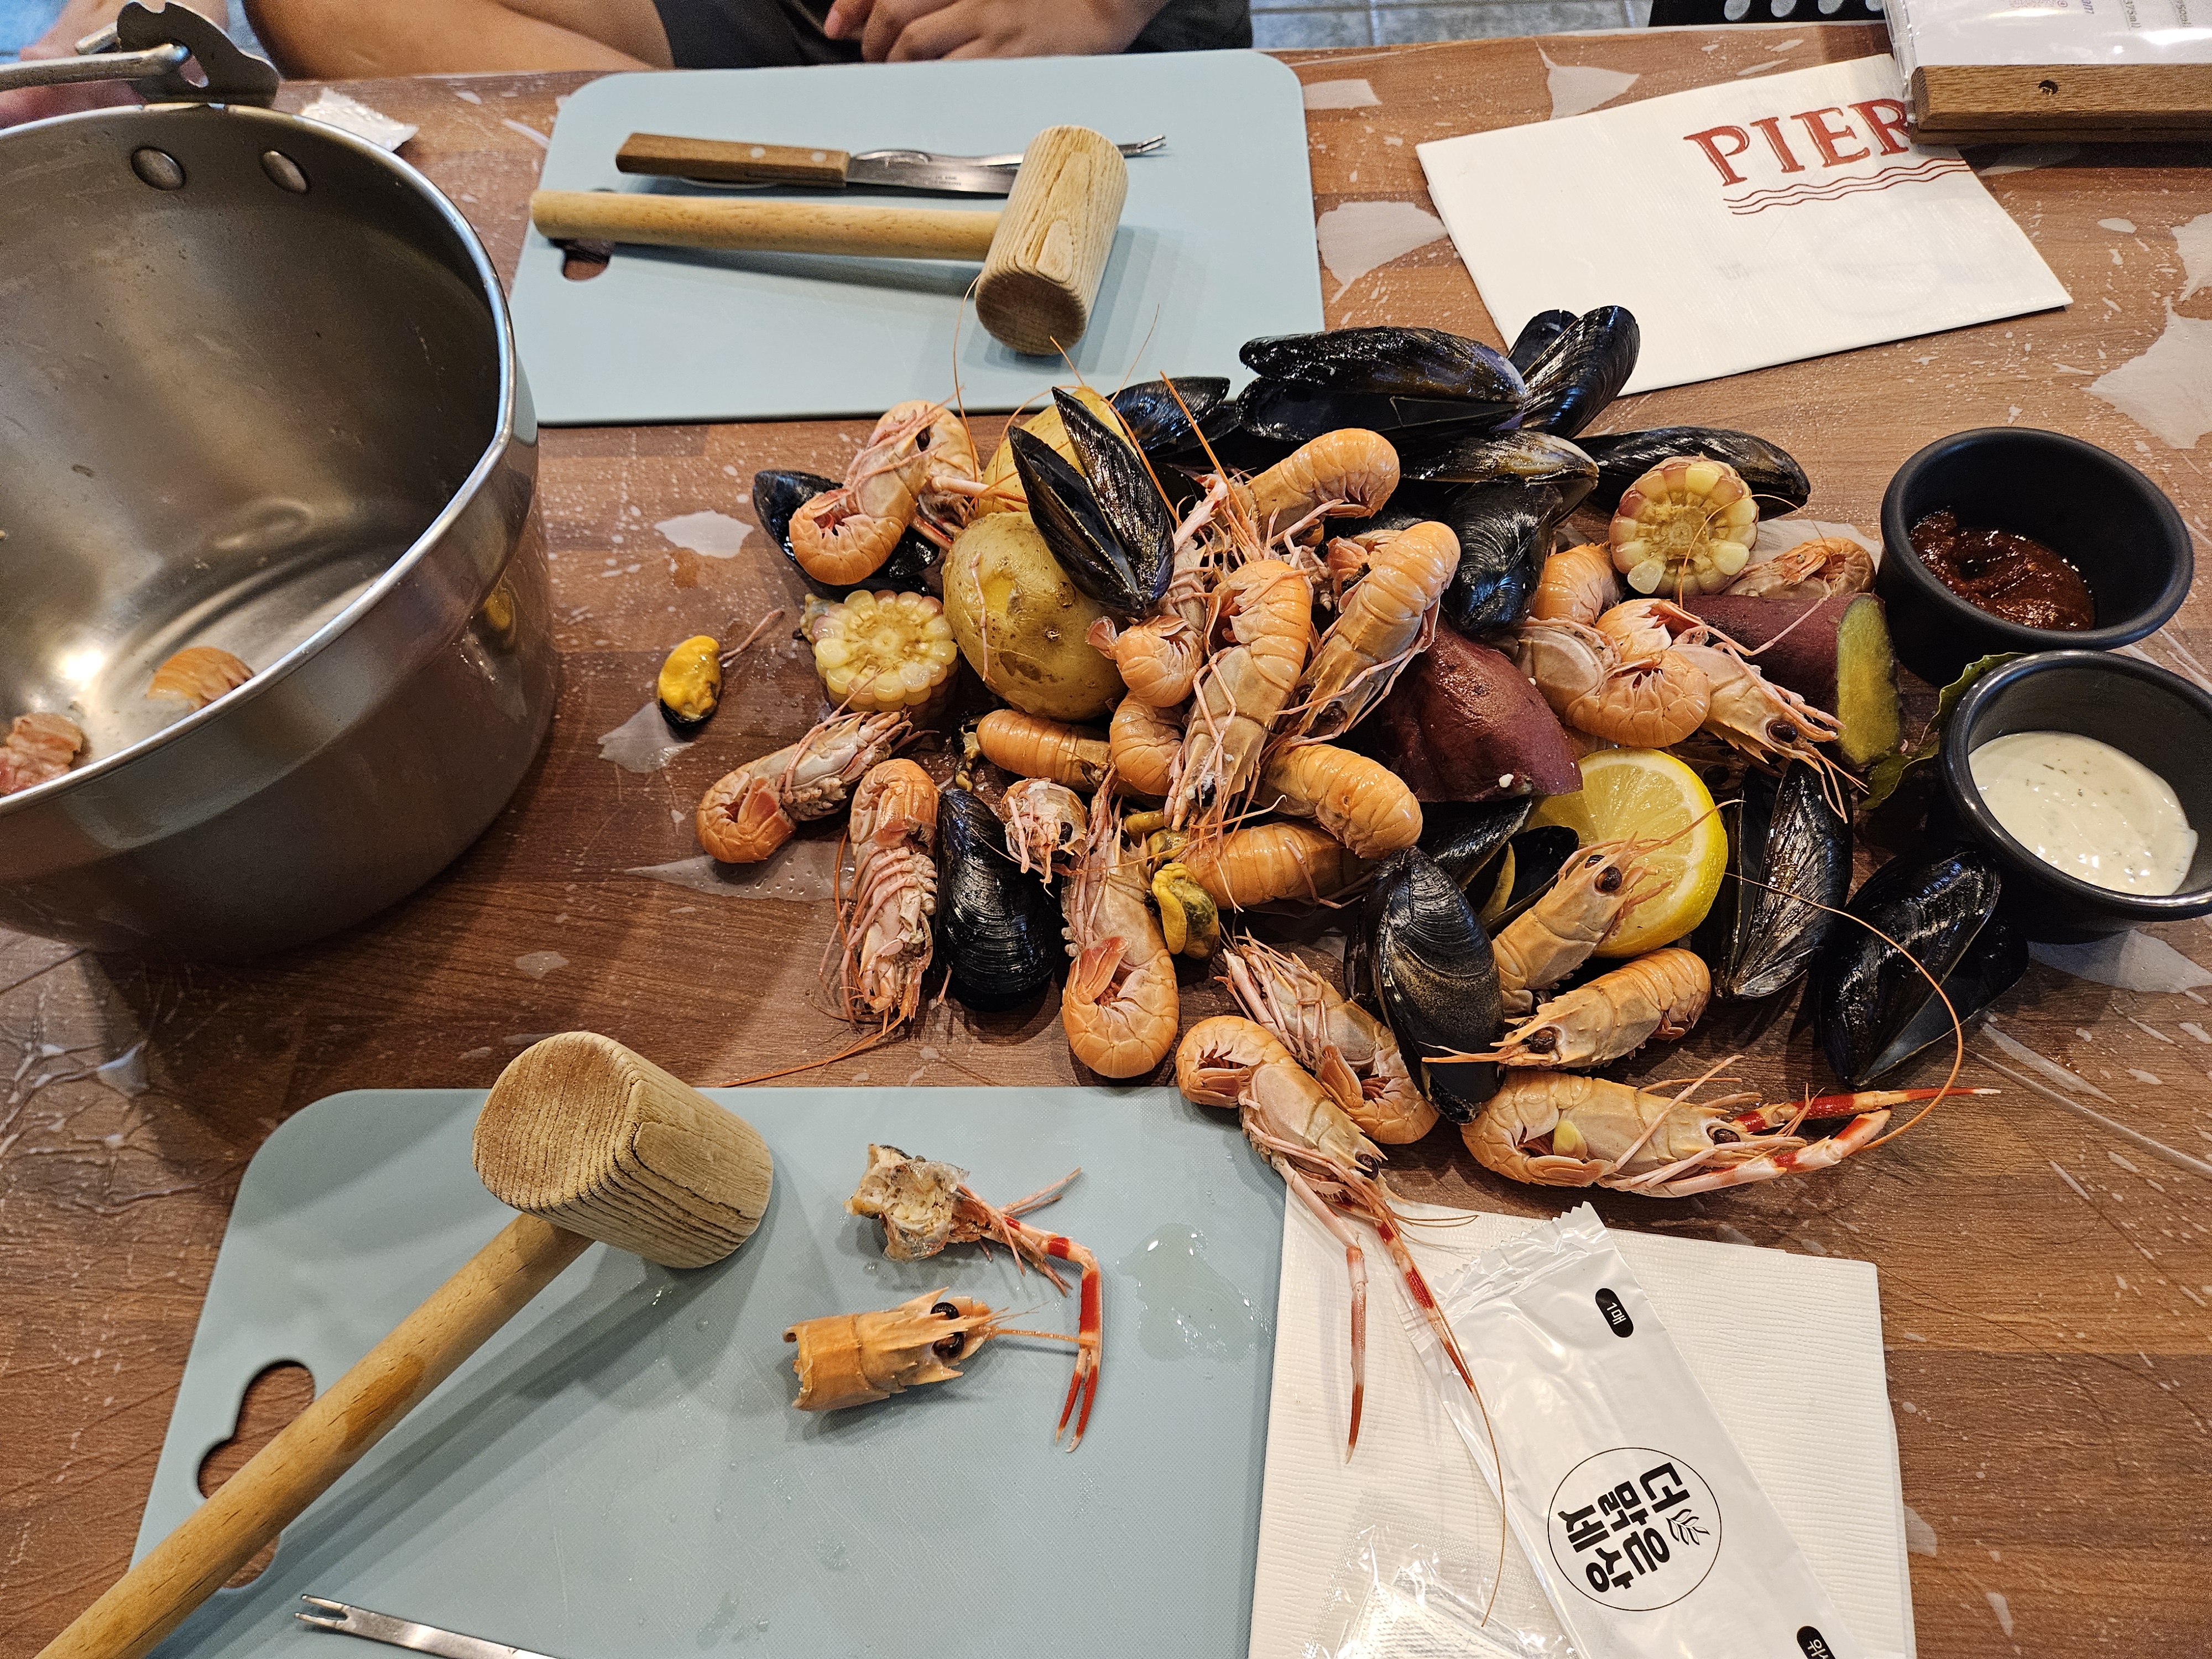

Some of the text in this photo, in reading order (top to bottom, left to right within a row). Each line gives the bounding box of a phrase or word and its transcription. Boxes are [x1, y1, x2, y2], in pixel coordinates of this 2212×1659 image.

[1683, 98, 1911, 187] PIER
[1606, 1302, 1627, 1325] 1매
[1597, 1480, 1671, 1575] 맑은
[1639, 1462, 1691, 1512] 더
[1558, 1504, 1635, 1593] 세상
